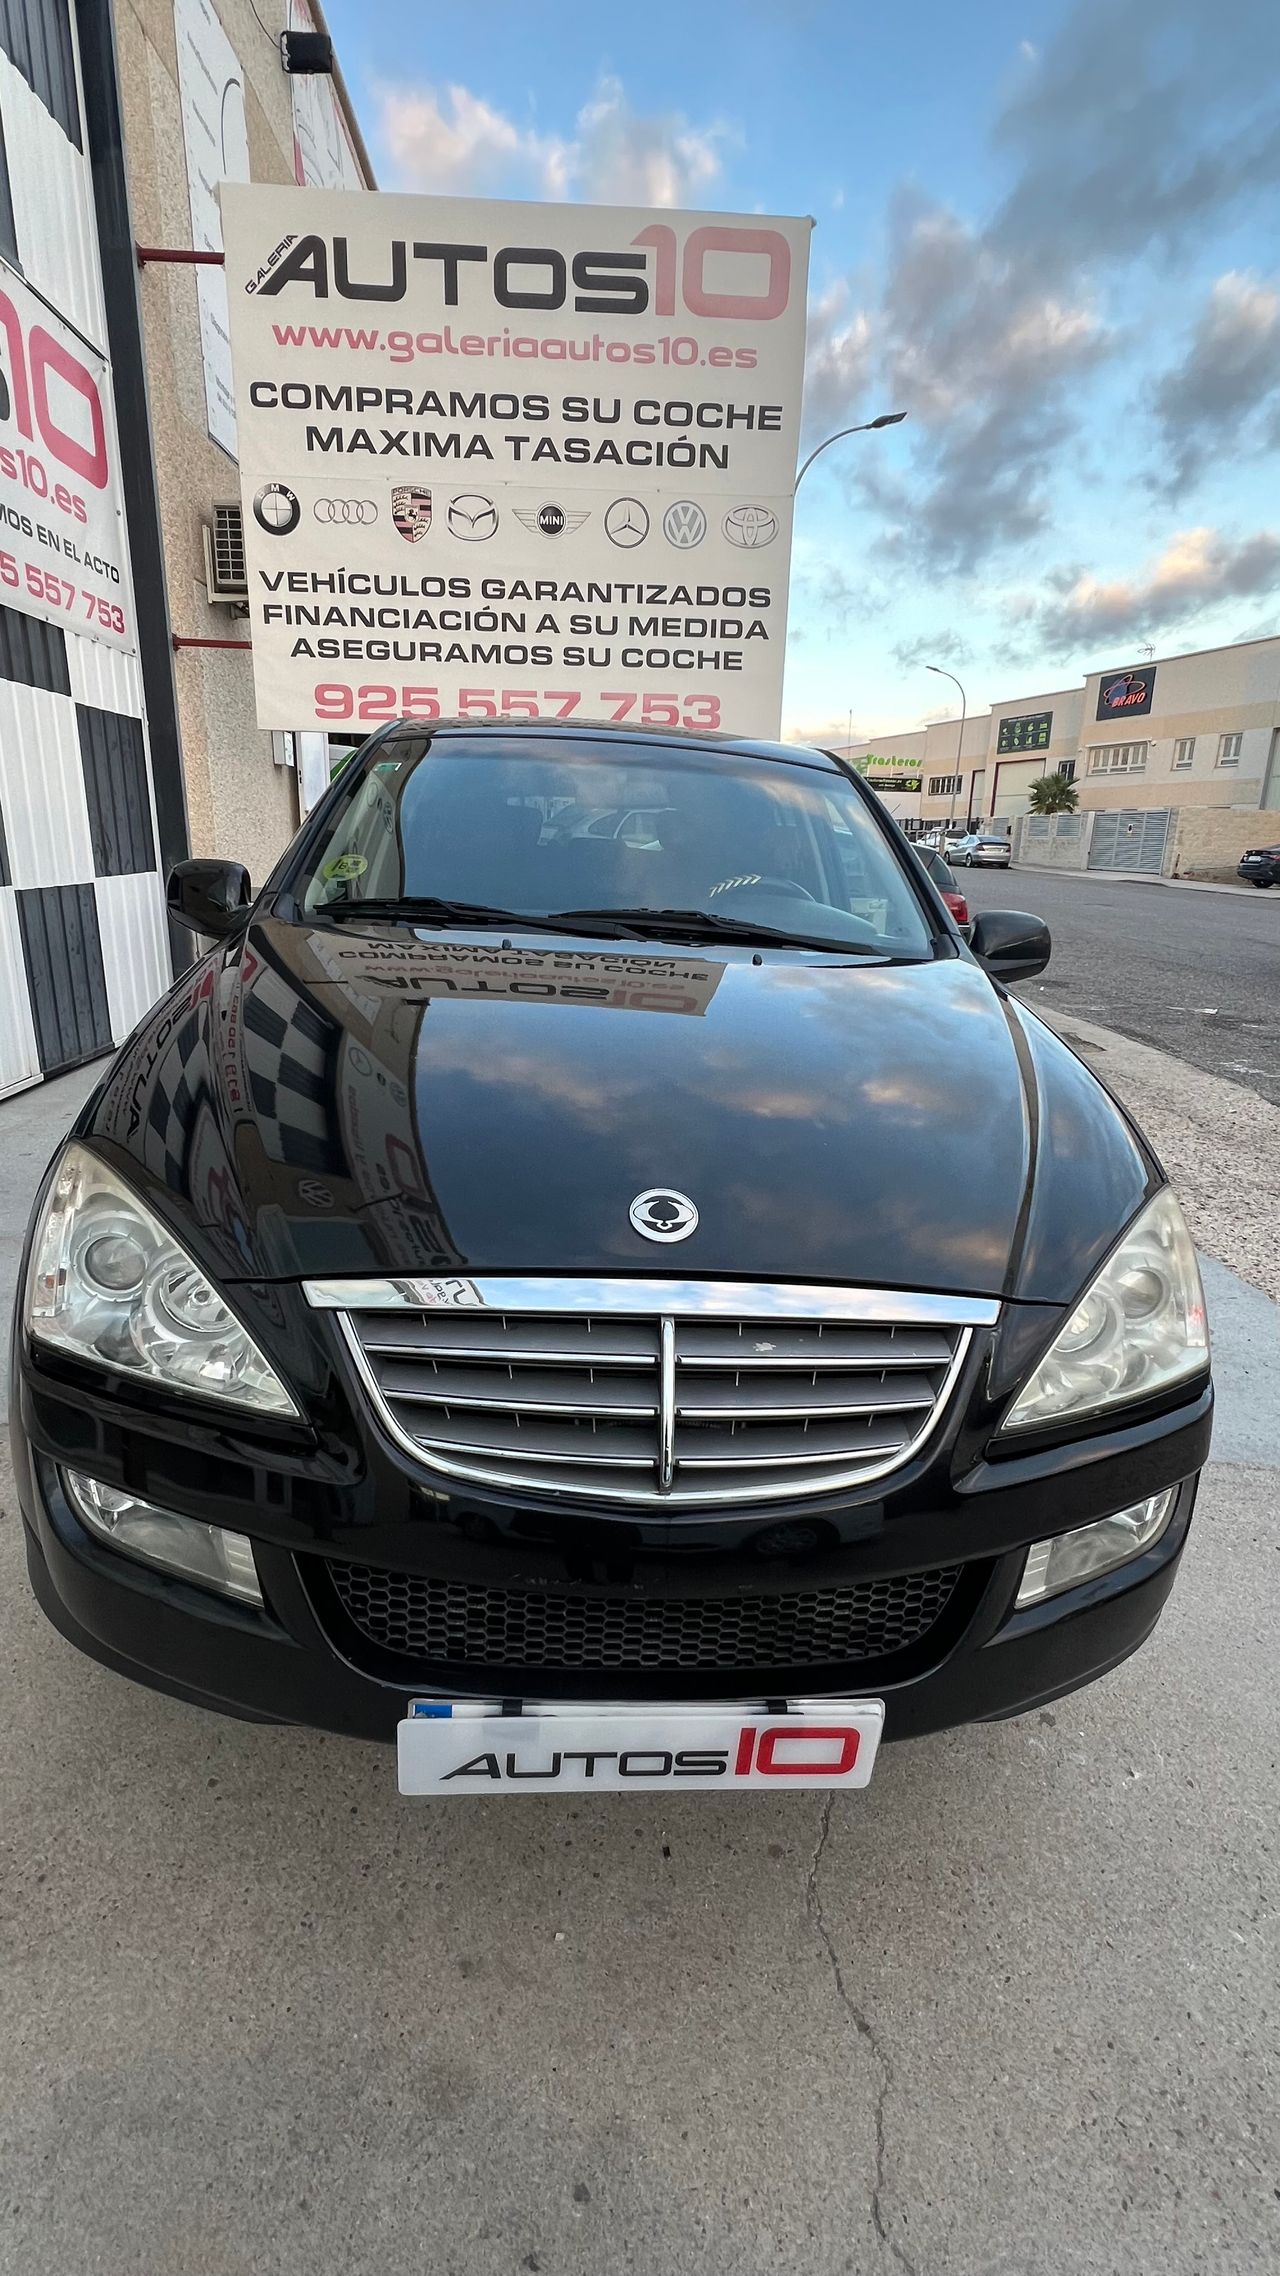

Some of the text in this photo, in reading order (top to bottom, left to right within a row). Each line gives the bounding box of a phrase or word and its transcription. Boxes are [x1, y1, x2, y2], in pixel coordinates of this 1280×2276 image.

[245, 235, 299, 295] GALERIA
[271, 325, 758, 369] www.galeriaautos10.es
[249, 381, 550, 422] COMPRAMOS
[562, 398, 621, 424] SU
[633, 400, 783, 431] COCHE
[305, 427, 729, 469] MAXIMA TASACIÓN
[539, 514, 563, 526] MINI
[36, 523, 60, 552] EN
[63, 538, 81, 563] EL
[84, 551, 119, 584] ACTO
[25, 562, 75, 611] 557
[82, 590, 125, 634] 753
[259, 567, 771, 608] VEHÍCULOS GARANTIZADOS
[263, 605, 770, 640] FINANCIACIÓN A SU MEDIDA
[290, 637, 743, 671] ASEGURAMOS SU COCHE
[315, 683, 721, 730] 925 557 753
[1111, 692, 1146, 708] BRAVO
[439, 1727, 861, 1780] AUTOS10
